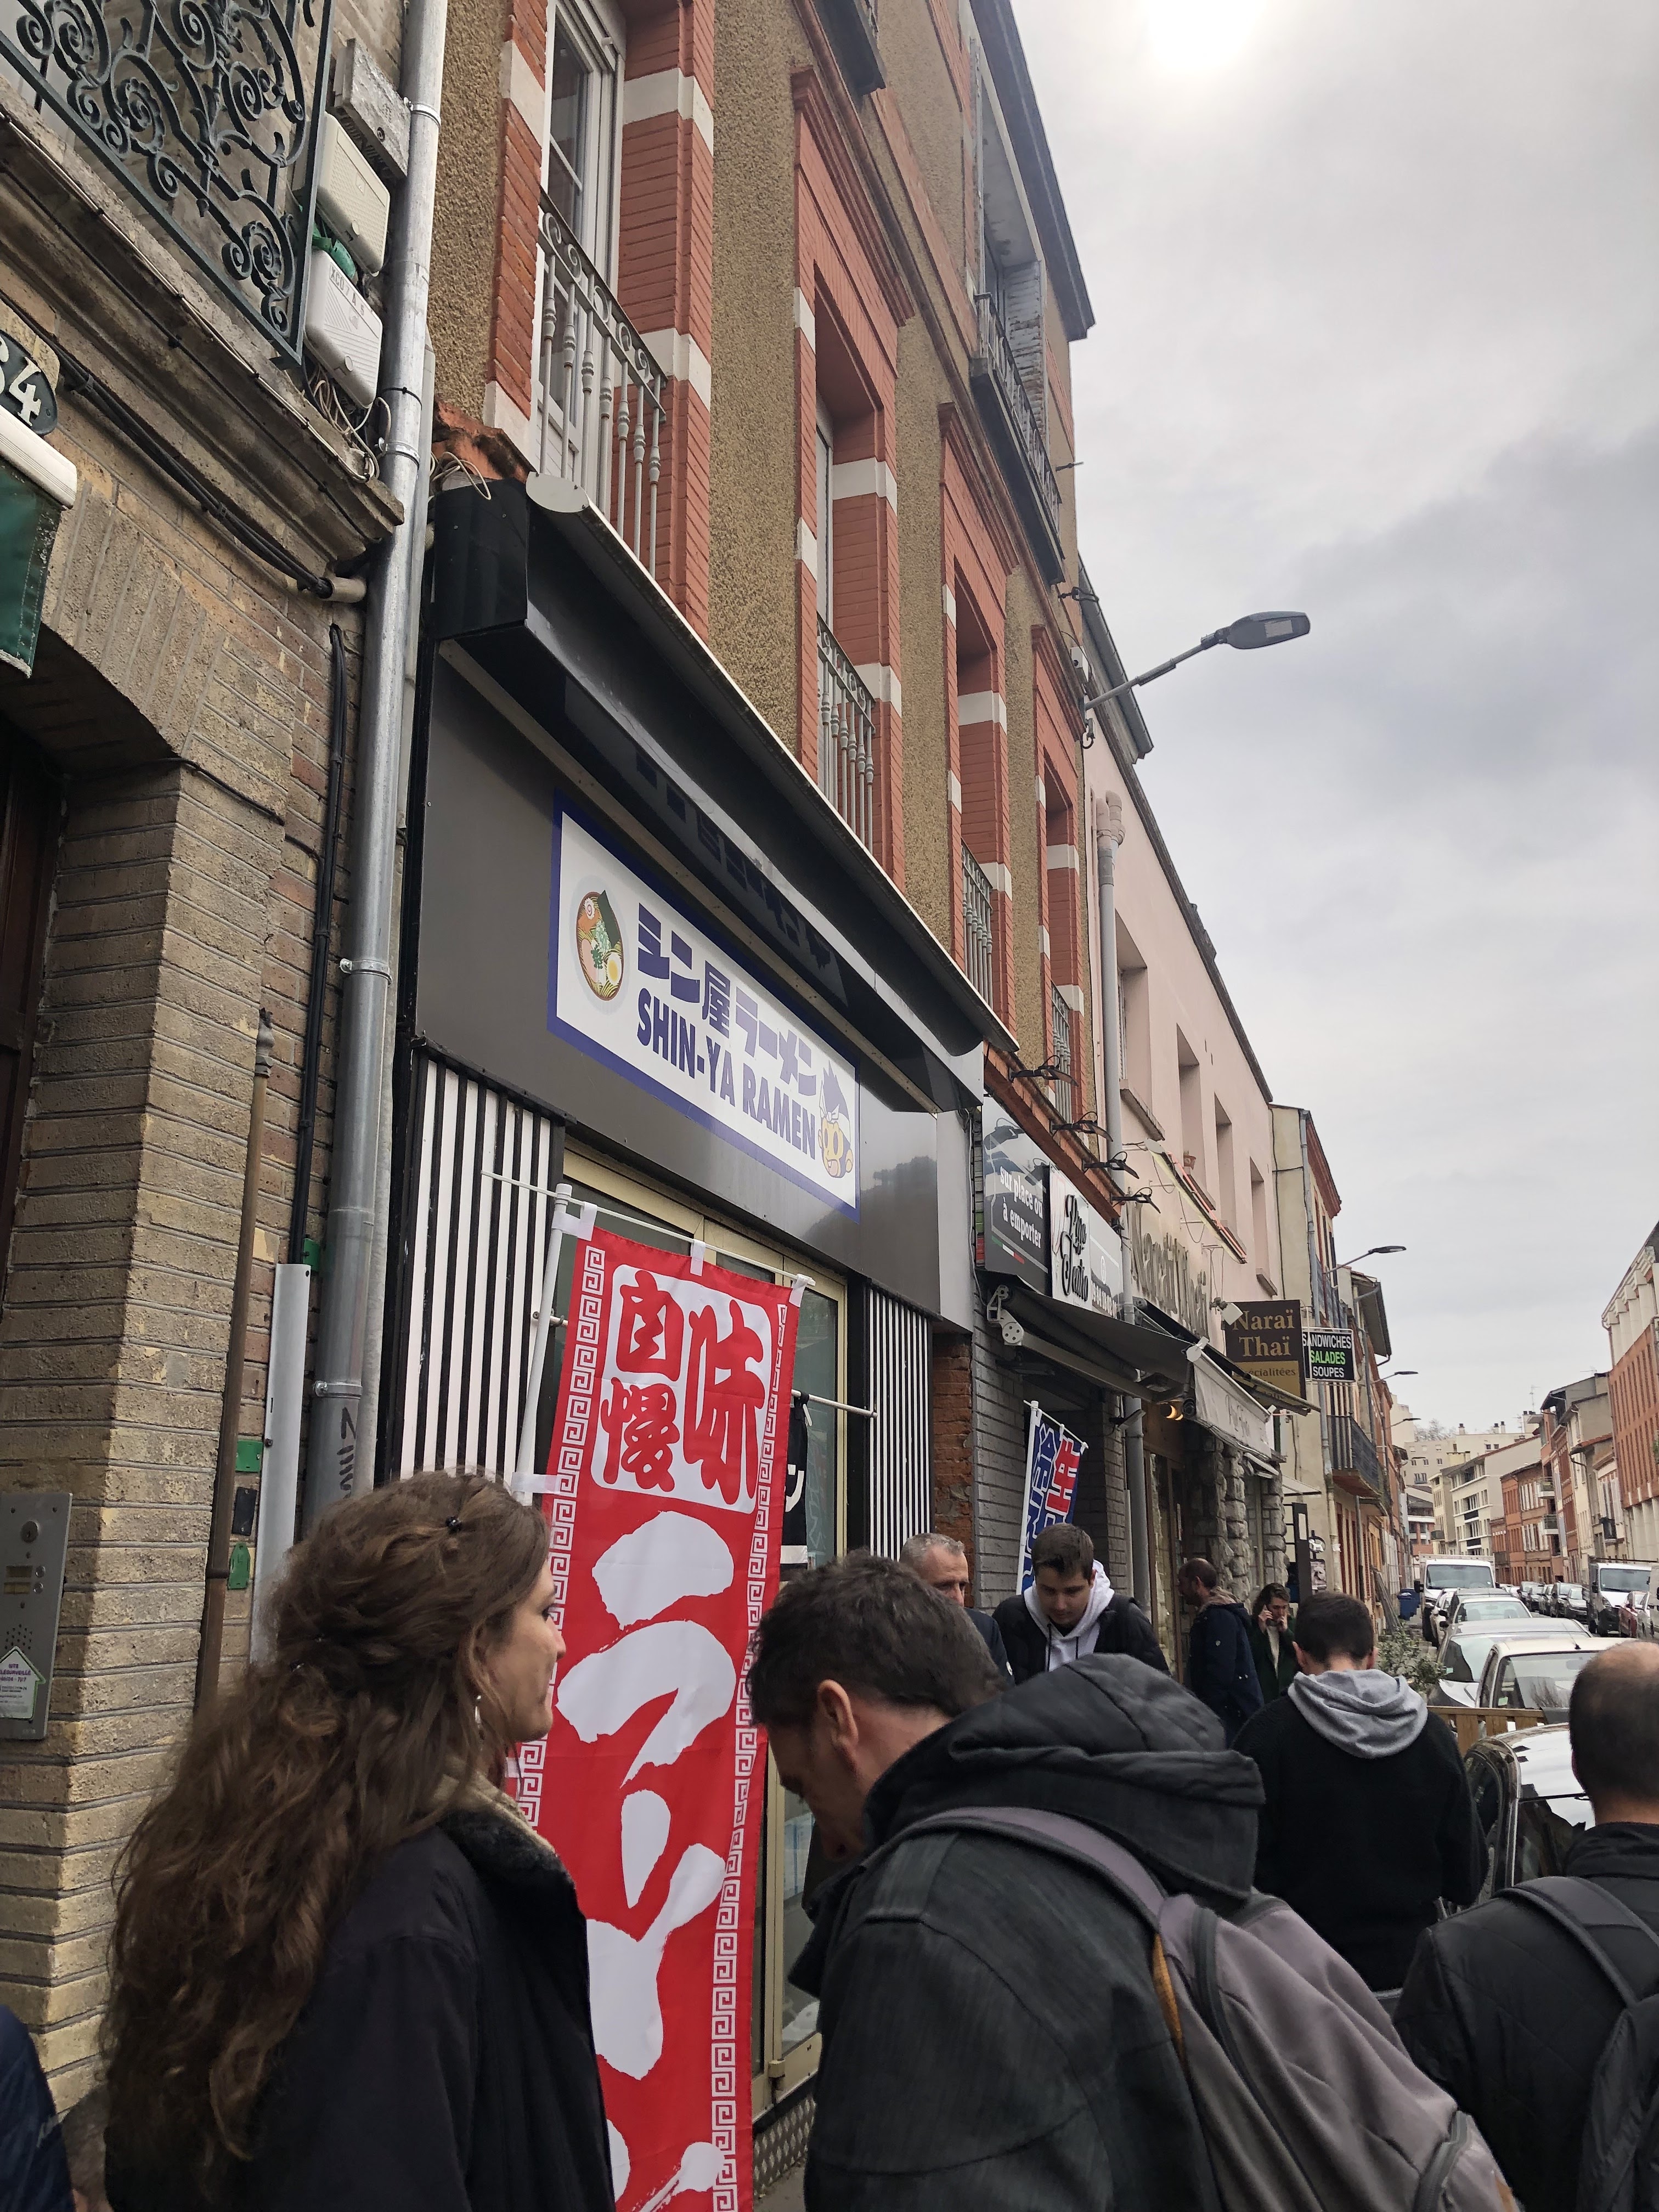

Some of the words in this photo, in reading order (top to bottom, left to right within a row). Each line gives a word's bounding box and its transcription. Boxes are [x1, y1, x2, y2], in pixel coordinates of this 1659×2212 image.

[638, 902, 816, 1096] シン屋ラーメン
[637, 988, 735, 1106] SHIN-YA
[743, 1063, 816, 1159] RAMEN
[1000, 1166, 1012, 1192] sur
[1014, 1175, 1034, 1210] place
[1034, 1197, 1043, 1219] ou
[1003, 1196, 1008, 1222] à
[1010, 1209, 1042, 1249] emporter
[1233, 1309, 1295, 1331] Naraï
[1239, 1335, 1291, 1357] Thaï
[1302, 1333, 1351, 1349] SANDWICHES
[1310, 1350, 1346, 1365] SALADES
[1313, 1365, 1345, 1378] SOUPES
